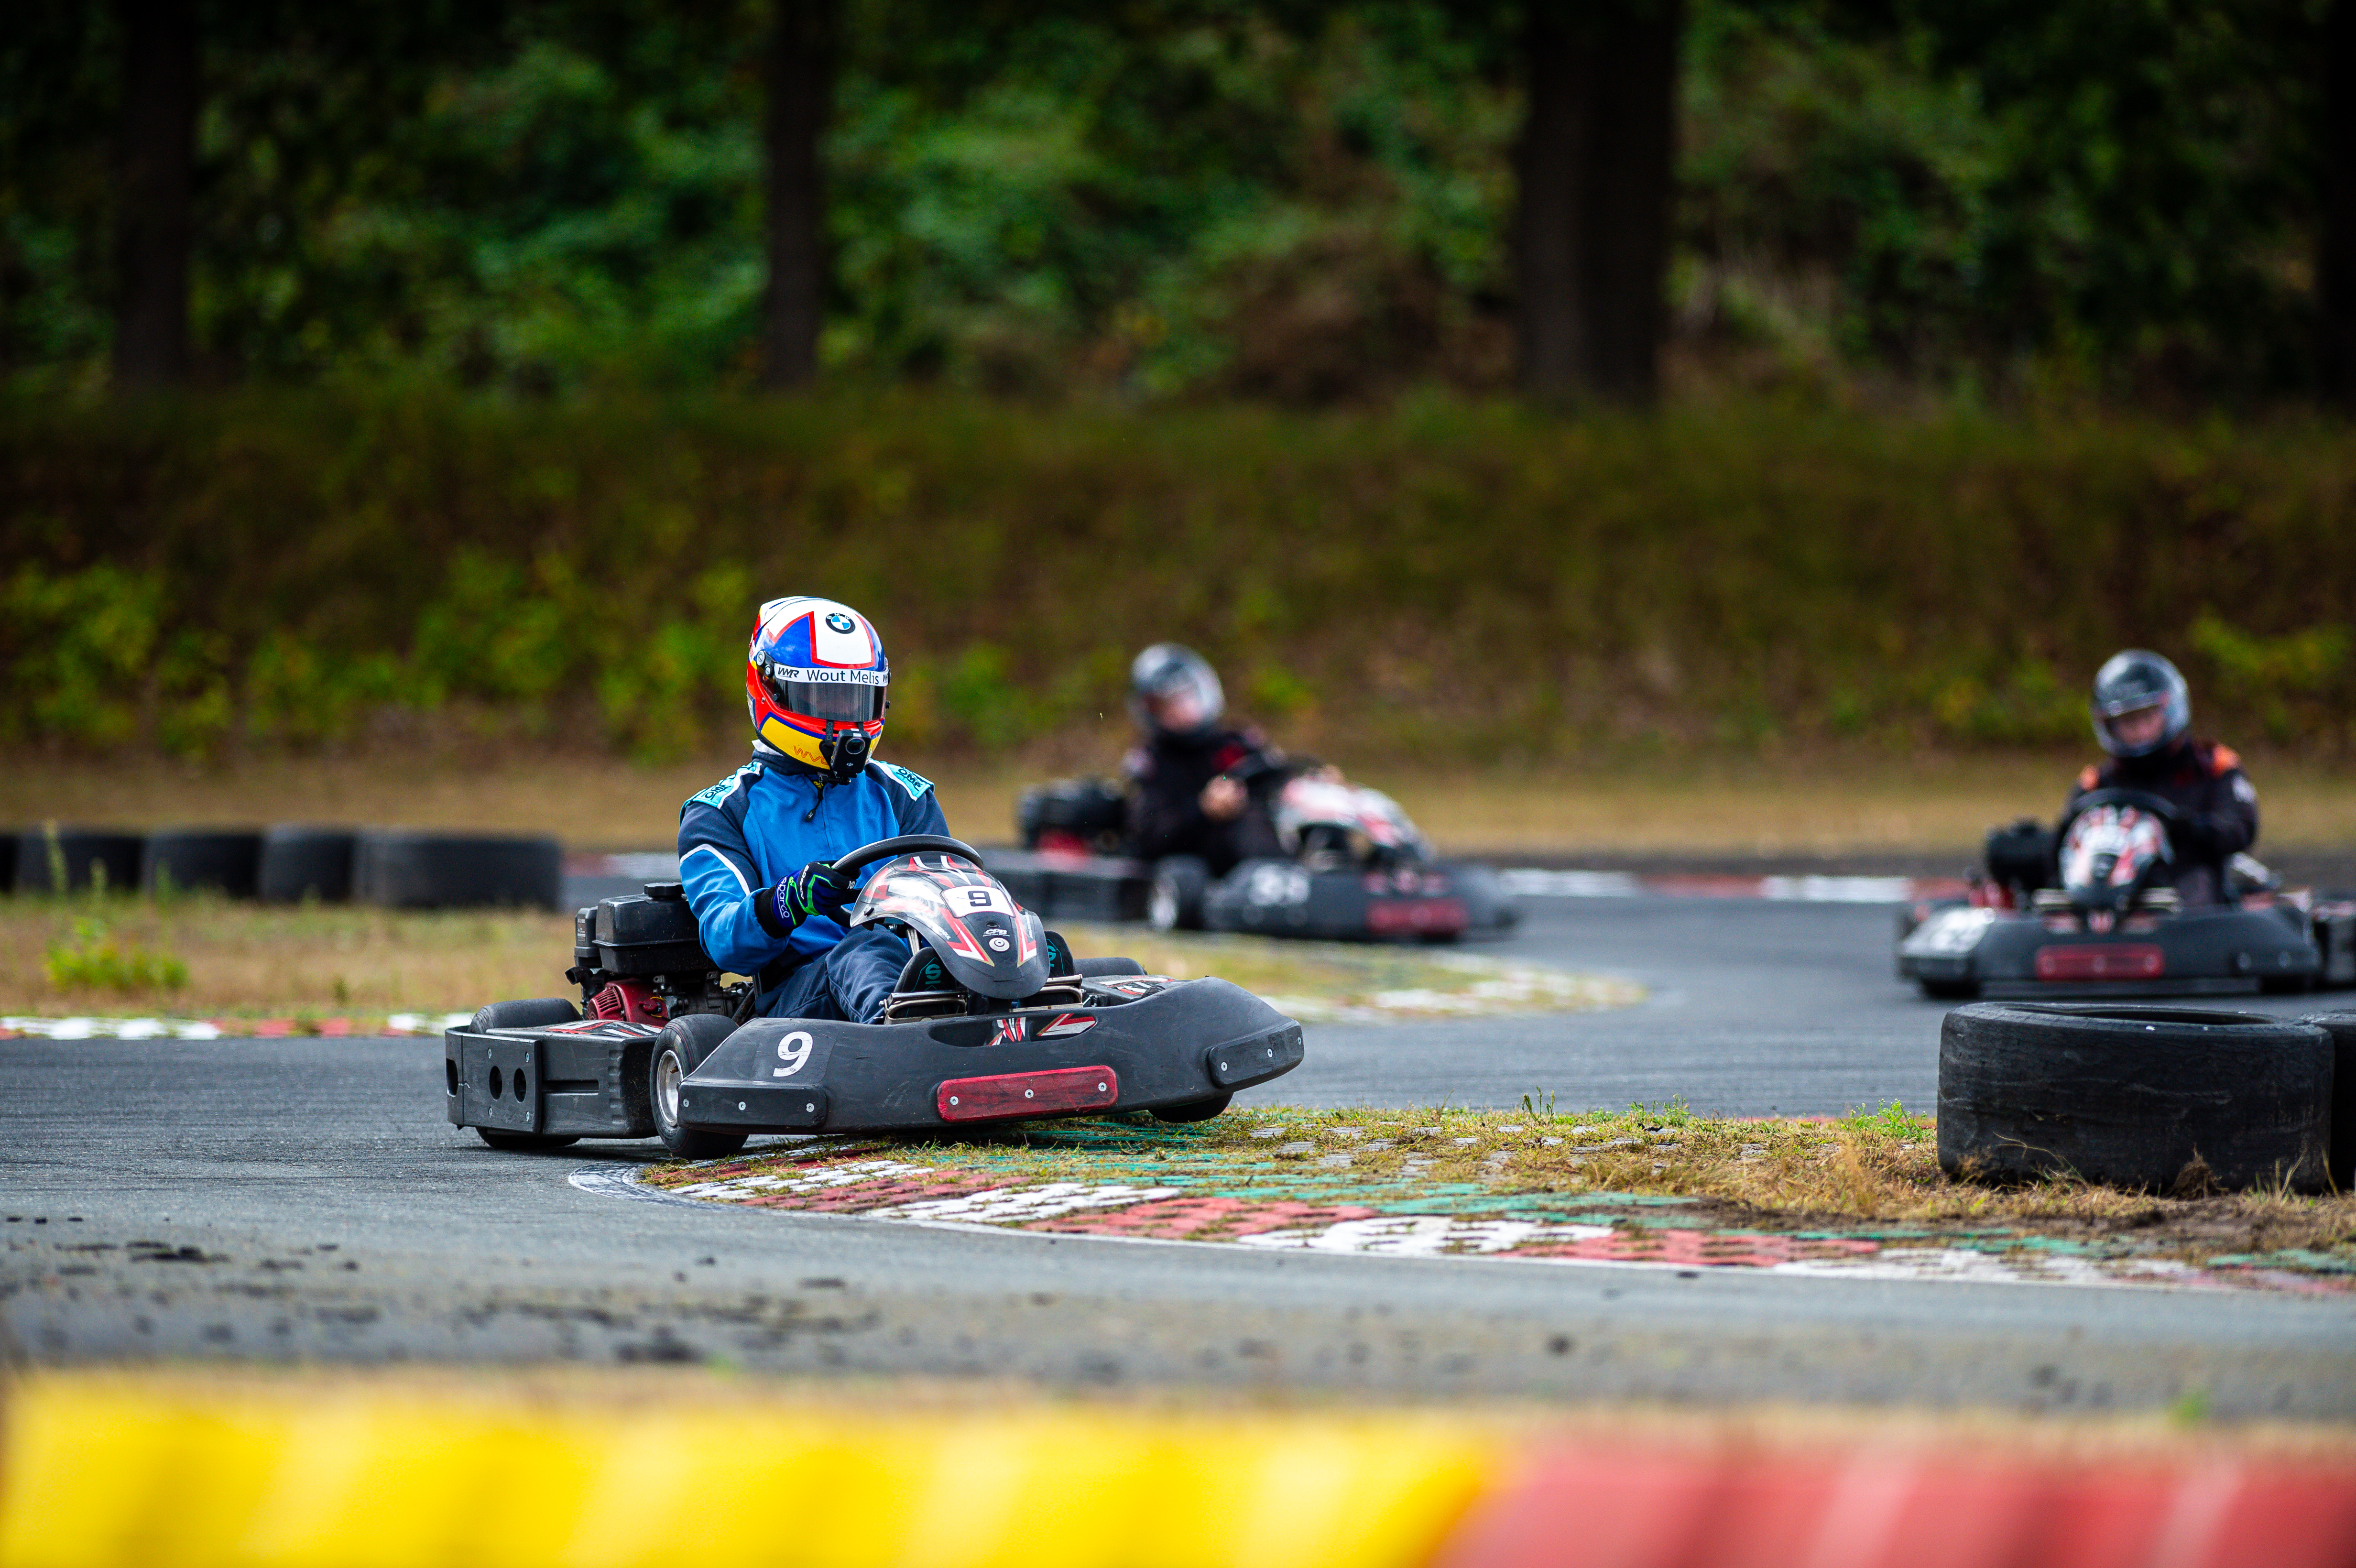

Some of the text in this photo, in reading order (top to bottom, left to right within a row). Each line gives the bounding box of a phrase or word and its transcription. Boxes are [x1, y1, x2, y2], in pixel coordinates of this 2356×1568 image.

[807, 669, 846, 682] Wout
[850, 670, 880, 685] Melis
[898, 769, 921, 788] OMP
[778, 877, 790, 918] sparco
[968, 891, 992, 907] 9
[773, 1031, 813, 1077] 9
